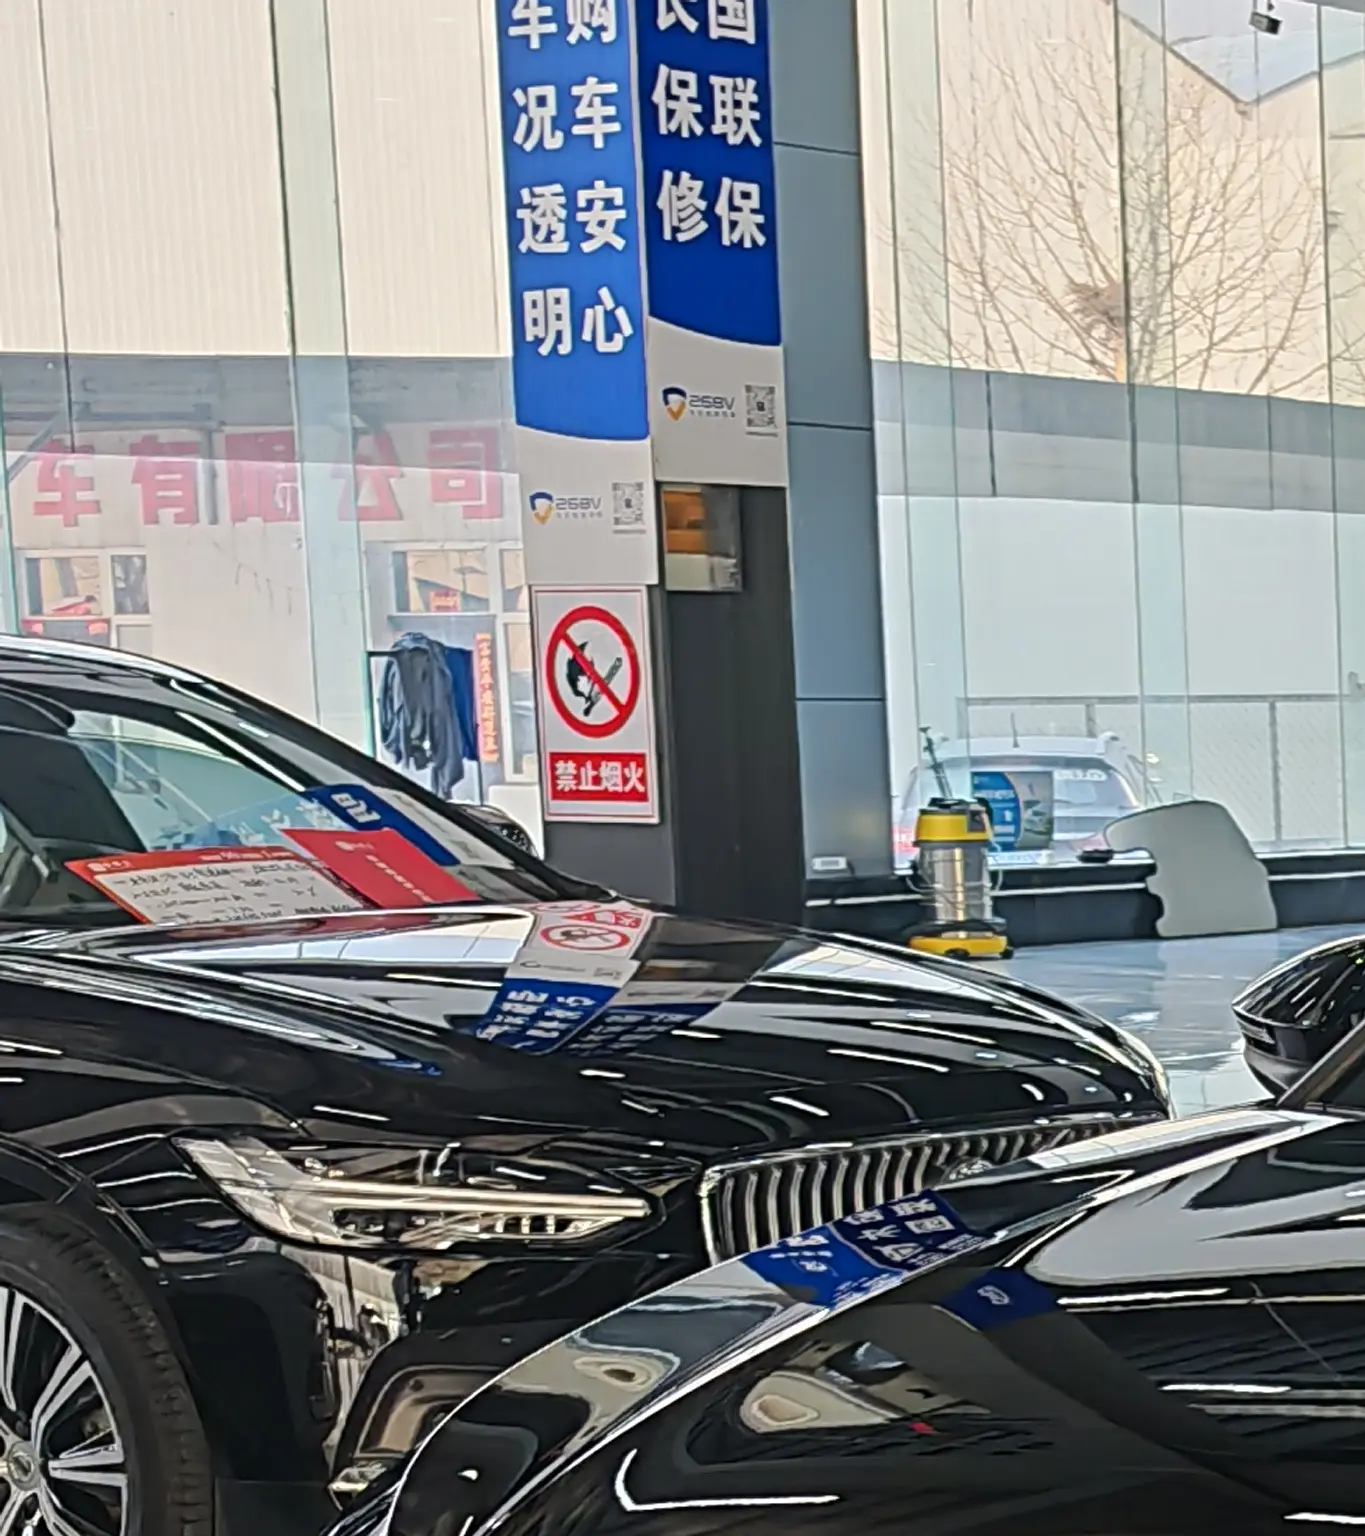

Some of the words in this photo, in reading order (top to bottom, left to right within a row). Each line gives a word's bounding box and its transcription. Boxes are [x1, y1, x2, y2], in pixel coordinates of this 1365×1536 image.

[508, 0, 573, 357] 车况透明
[566, 0, 634, 354] 购车安心
[554, 759, 646, 793] 禁止烟火
